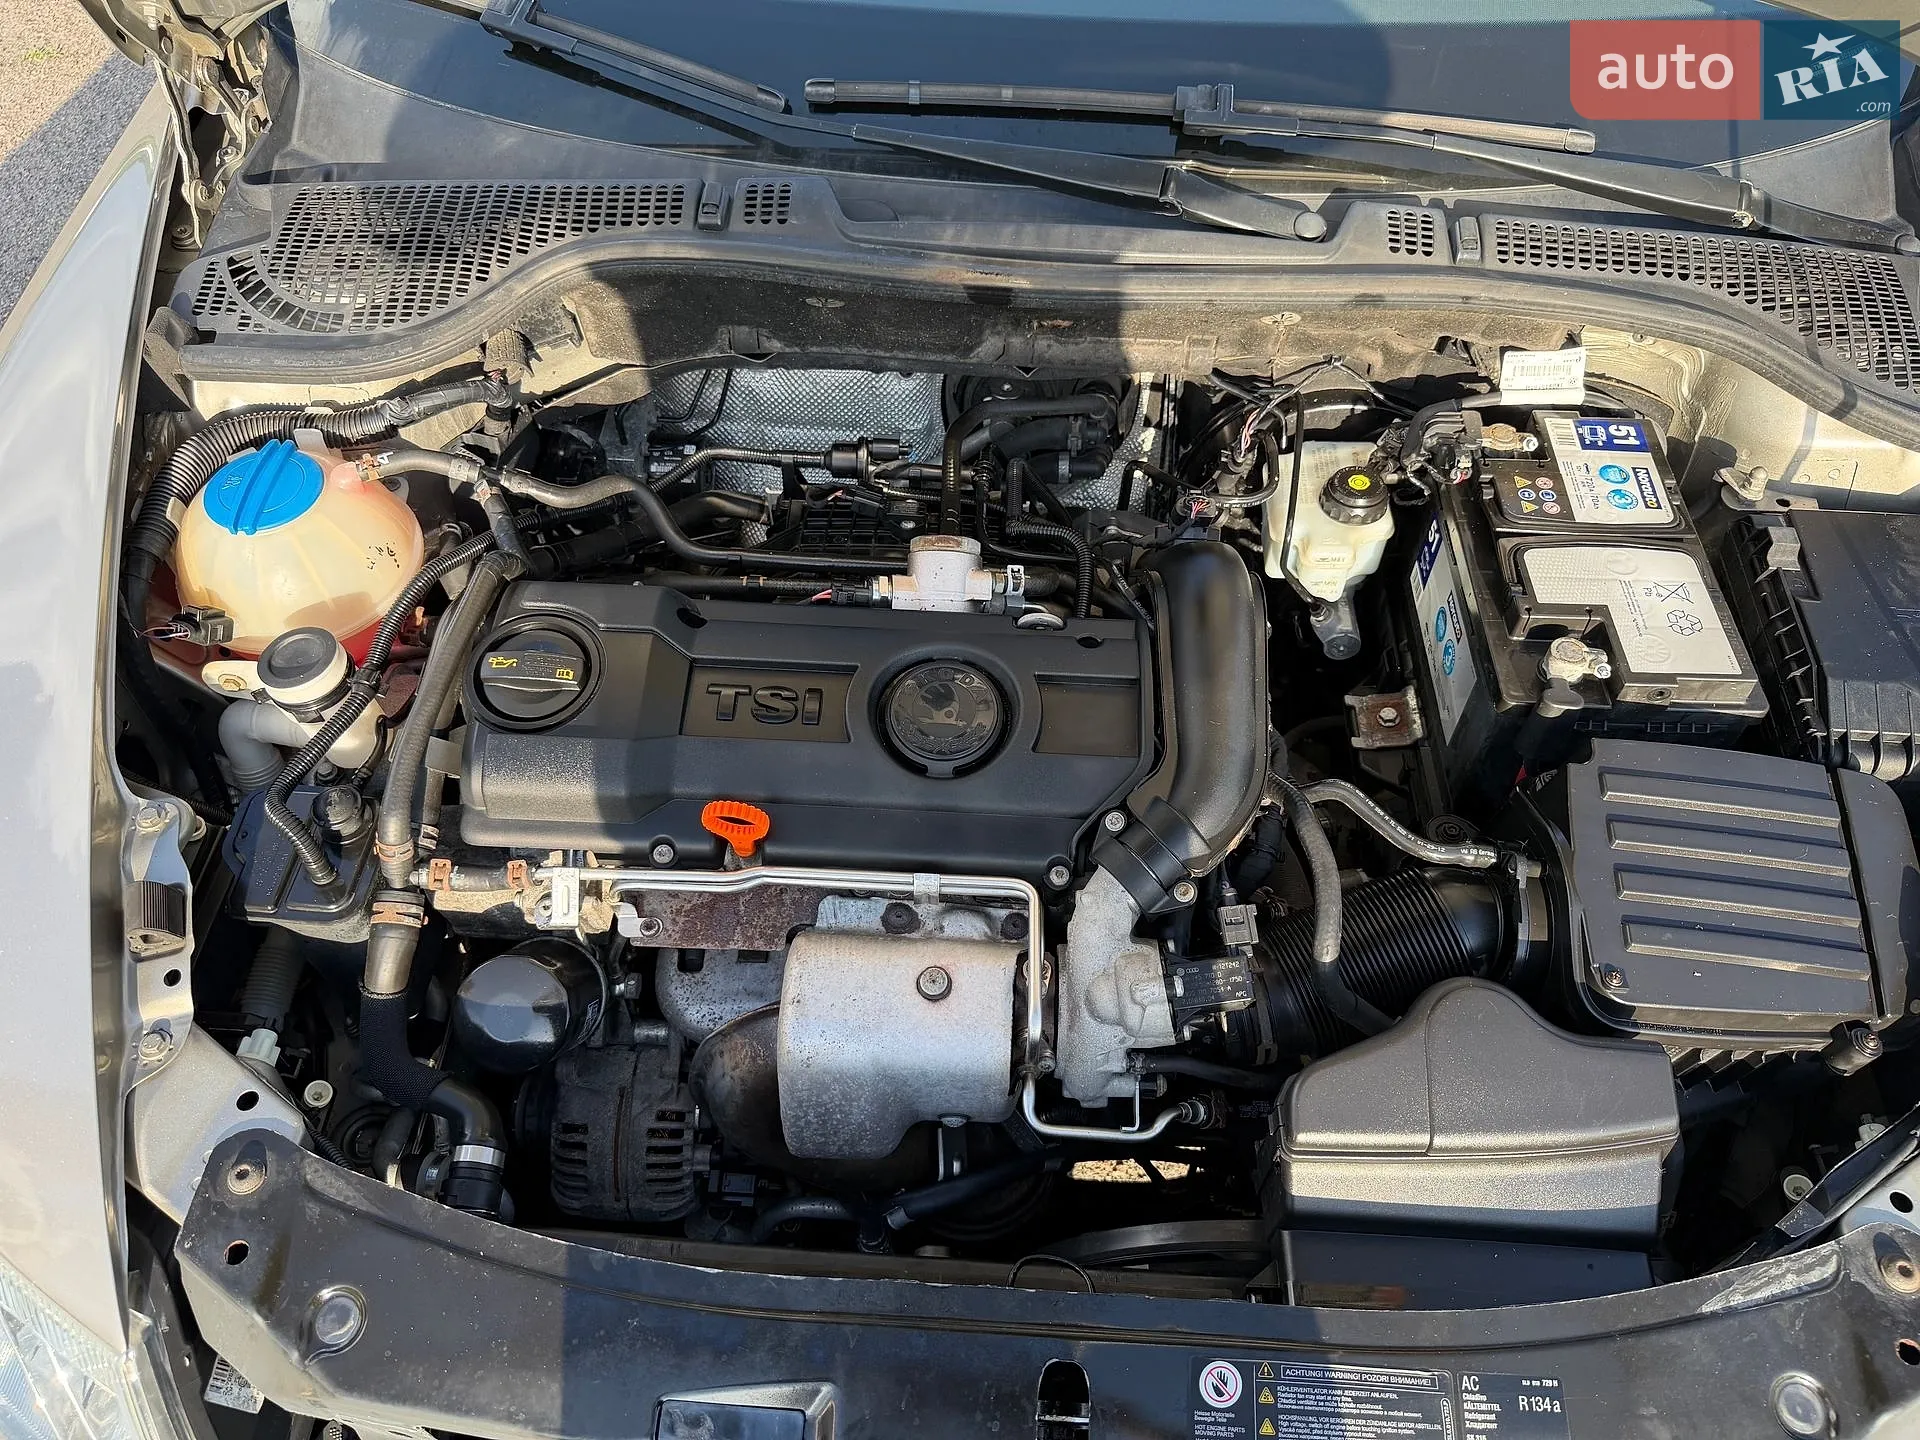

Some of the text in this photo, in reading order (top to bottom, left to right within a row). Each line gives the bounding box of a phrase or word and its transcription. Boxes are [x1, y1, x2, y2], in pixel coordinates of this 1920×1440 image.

[1608, 424, 1640, 445] 51
[1635, 468, 1658, 508] Norauto
[1428, 519, 1440, 553] 51
[706, 683, 823, 725] TSI
[1285, 1368, 1389, 1383] ACHTUNG! WARNING! POZOR!
[1462, 1375, 1479, 1391] AC
